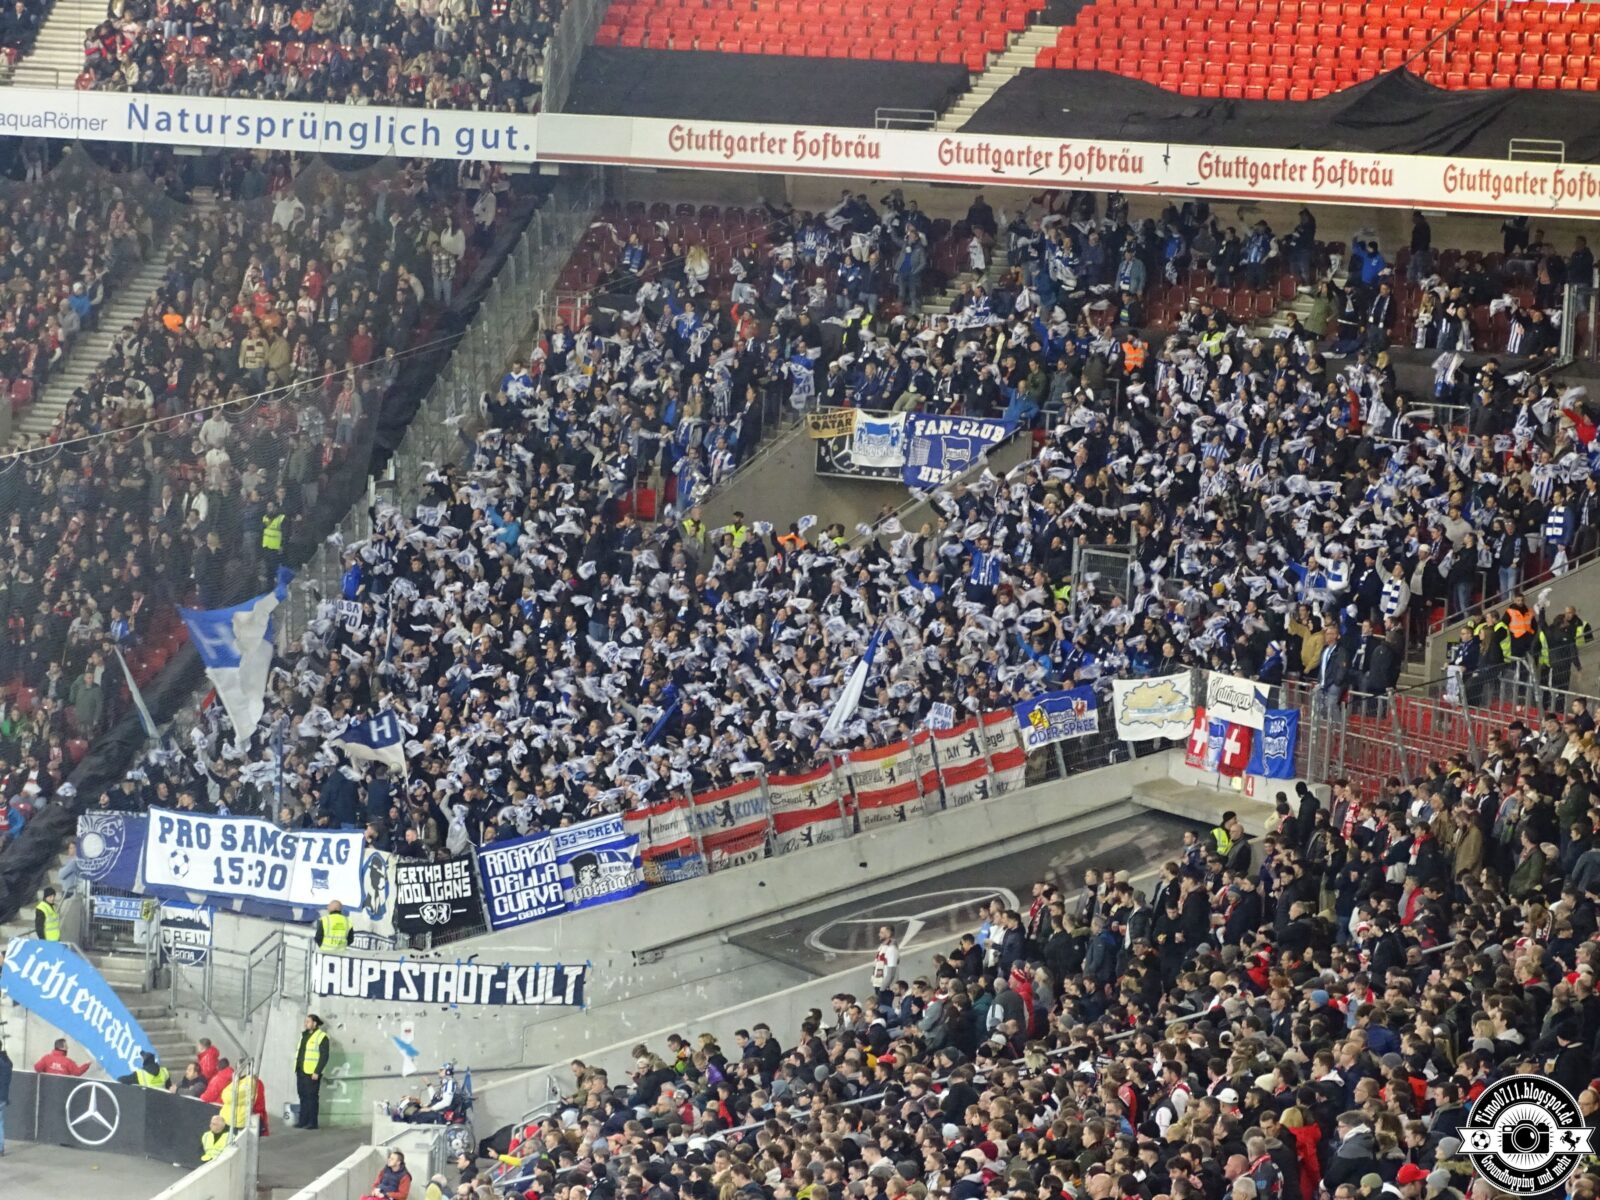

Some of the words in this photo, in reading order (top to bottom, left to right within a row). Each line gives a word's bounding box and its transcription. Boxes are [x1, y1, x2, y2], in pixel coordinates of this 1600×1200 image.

[127, 102, 441, 150] Natursprünglich
[455, 125, 531, 155] gut.
[668, 125, 787, 159] Stuttgarter
[792, 130, 881, 162] Hofbräu
[938, 138, 1053, 172] Stuttgarter
[1058, 143, 1144, 175] Hofbräu
[1198, 151, 1307, 187] Stuttgarter
[1312, 159, 1394, 189] Hofbräu
[1443, 164, 1547, 200] Stuttgarter
[1553, 168, 1600, 204] Hofb
[811, 418, 852, 432] QATAR
[914, 420, 1006, 442] FAN-CLUB
[369, 716, 392, 742] H
[1029, 718, 1096, 746] ODER-SPREE
[159, 816, 211, 850] PRO
[221, 824, 351, 866] SAMSTAG
[587, 820, 624, 839] CREW
[213, 856, 288, 891] 15:30
[444, 860, 469, 880] BSC
[485, 839, 556, 877] RAGAZZI
[398, 877, 472, 905] HOOLIGANS
[490, 863, 560, 897] DELLA
[494, 882, 564, 916] CURVA
